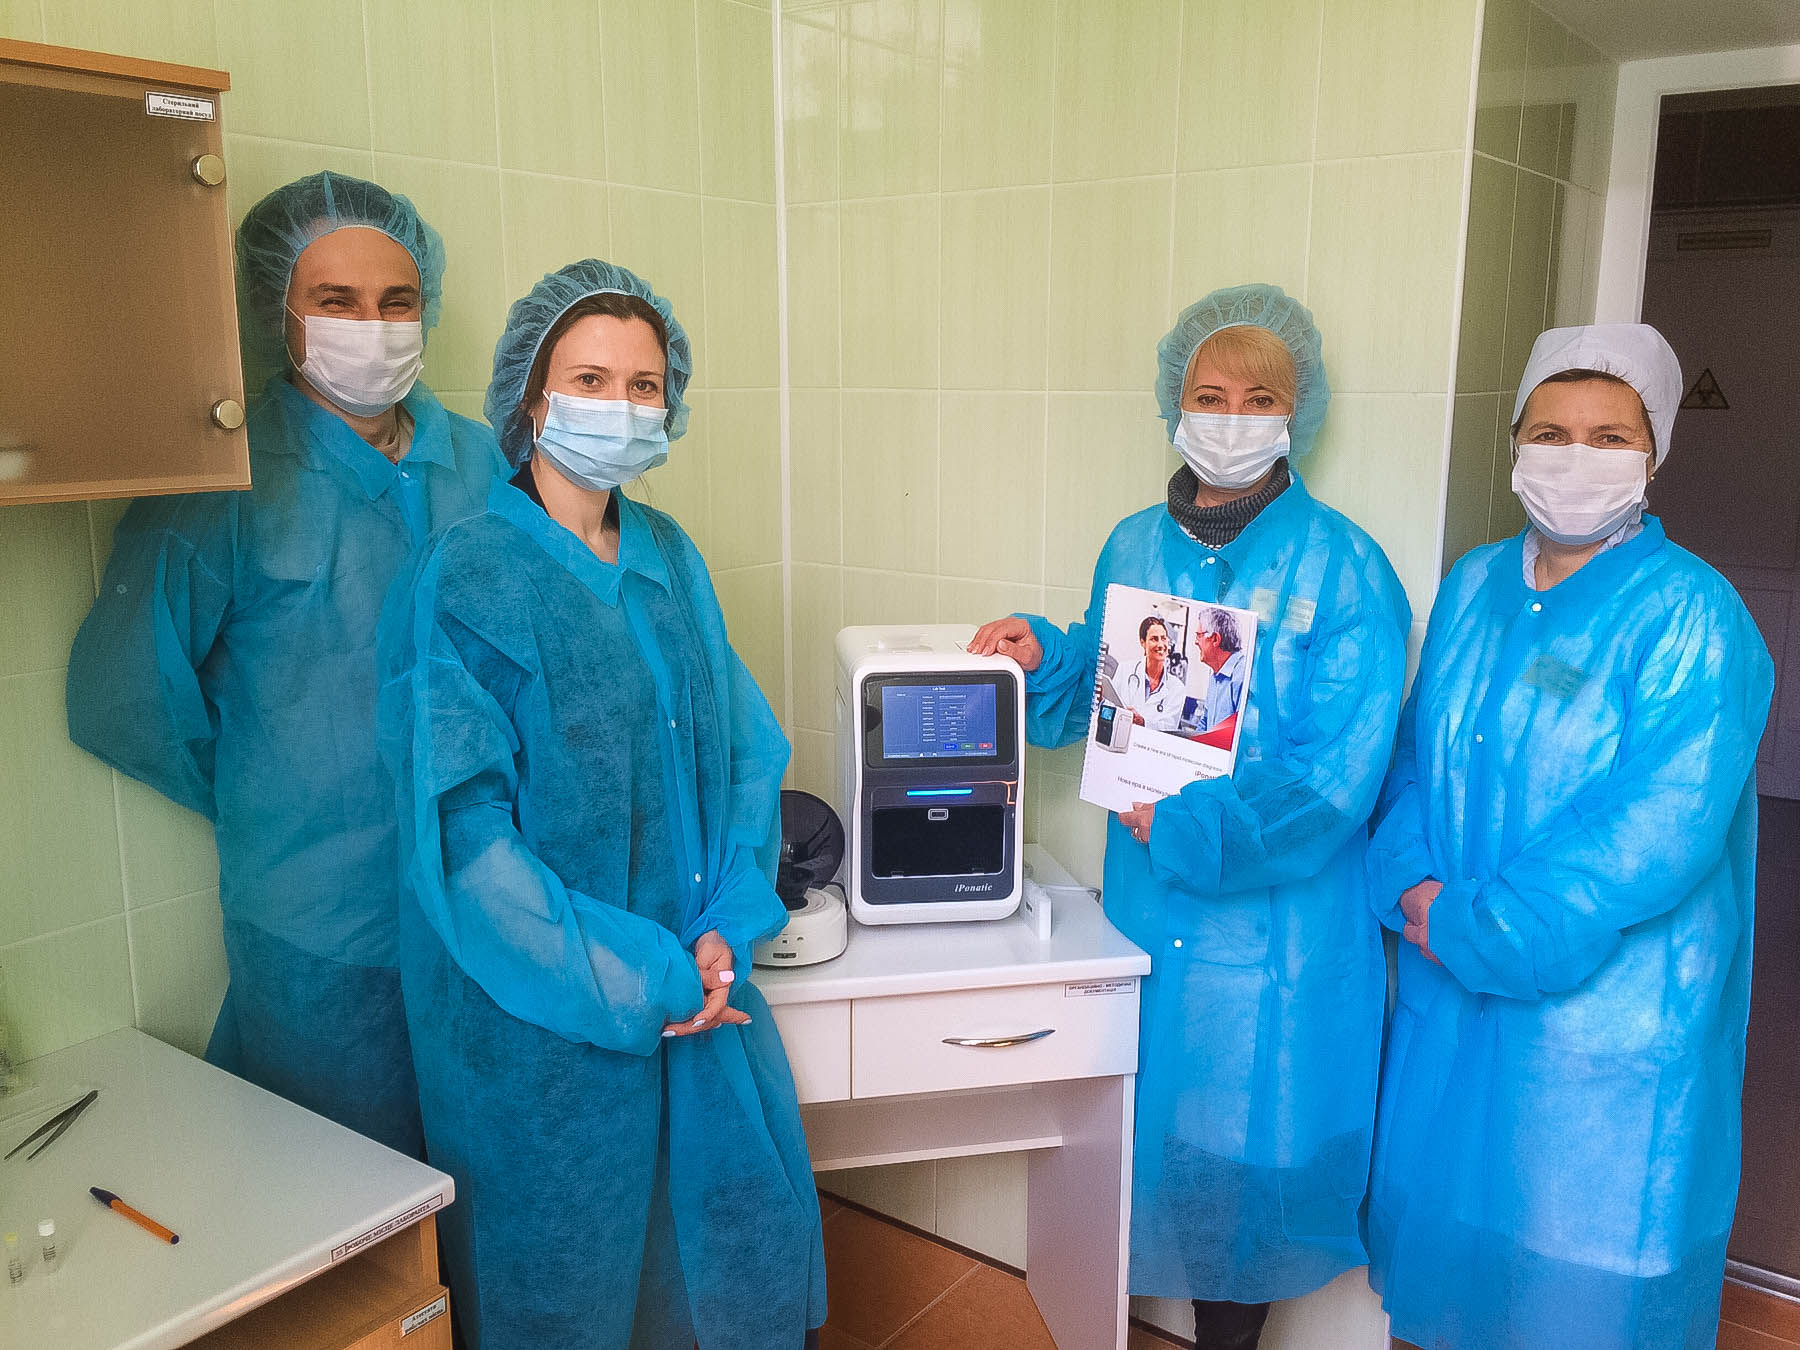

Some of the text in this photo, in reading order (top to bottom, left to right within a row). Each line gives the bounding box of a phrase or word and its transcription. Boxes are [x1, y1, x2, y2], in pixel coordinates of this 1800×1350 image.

[162, 98, 199, 108] Стерильний
[152, 106, 193, 115] лабораторний
[1117, 776, 1131, 786] Нова
[955, 883, 993, 892] iPonatic
